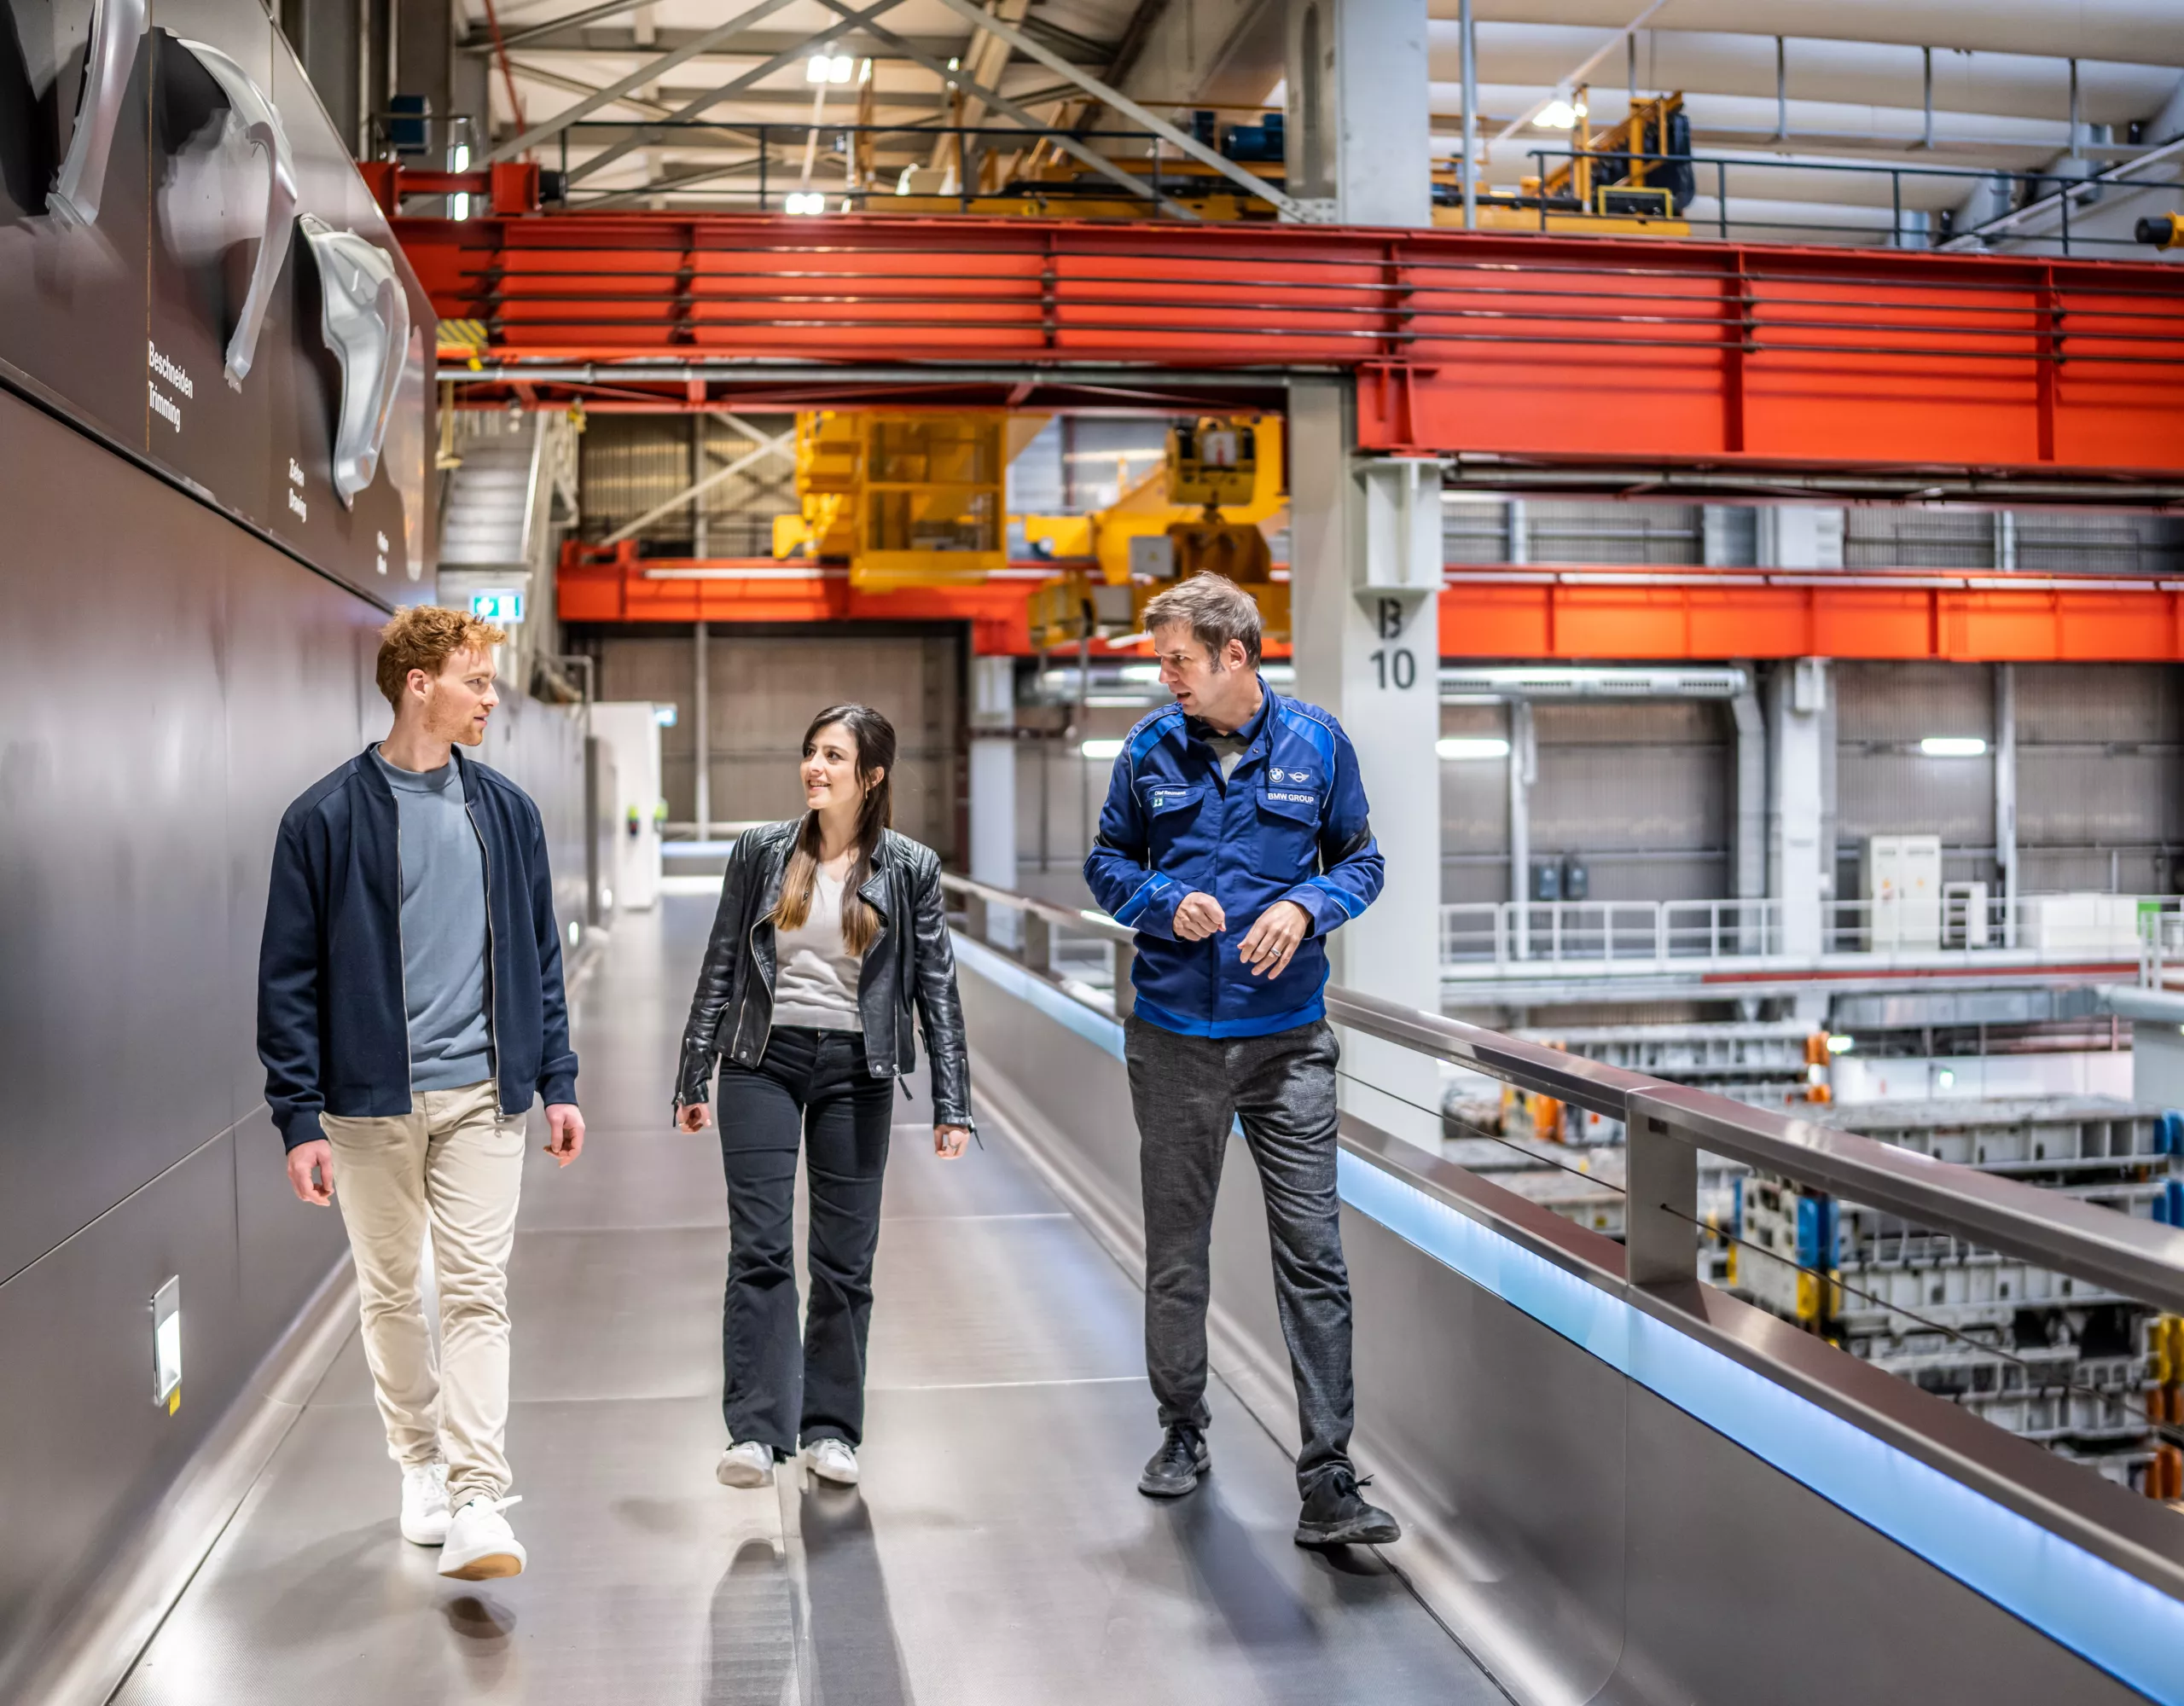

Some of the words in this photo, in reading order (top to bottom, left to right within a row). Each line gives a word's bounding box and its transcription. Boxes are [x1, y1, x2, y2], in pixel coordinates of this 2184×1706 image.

[148, 340, 194, 399] Beschneiden
[148, 380, 181, 433] Trimming
[1377, 596, 1403, 640] B
[1369, 648, 1416, 689] 10
[1268, 792, 1287, 801] BMW
[1288, 793, 1315, 804] GROUP
